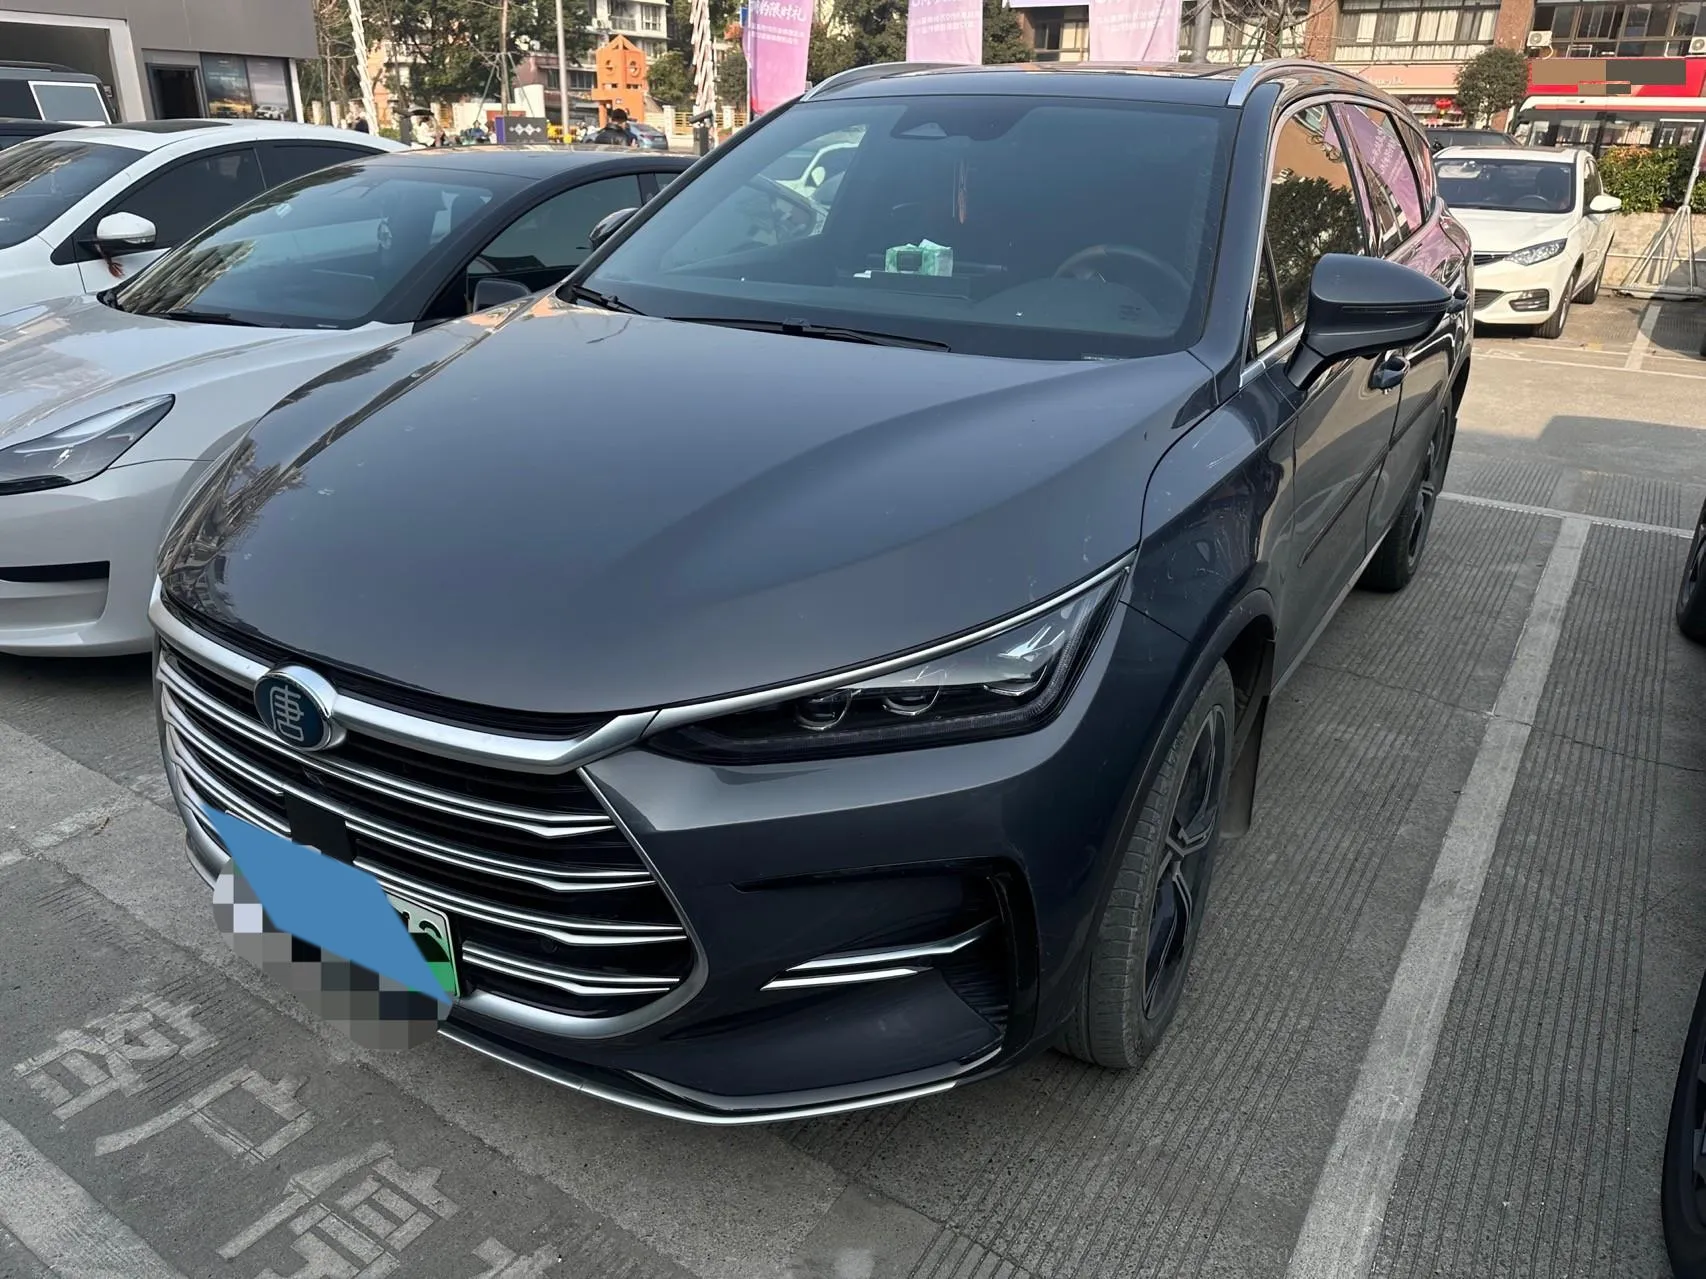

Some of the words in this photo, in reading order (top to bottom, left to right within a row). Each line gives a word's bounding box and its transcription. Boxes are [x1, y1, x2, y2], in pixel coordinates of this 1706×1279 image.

[752, 0, 807, 22] 的限时礼
[270, 685, 304, 742] 唐
